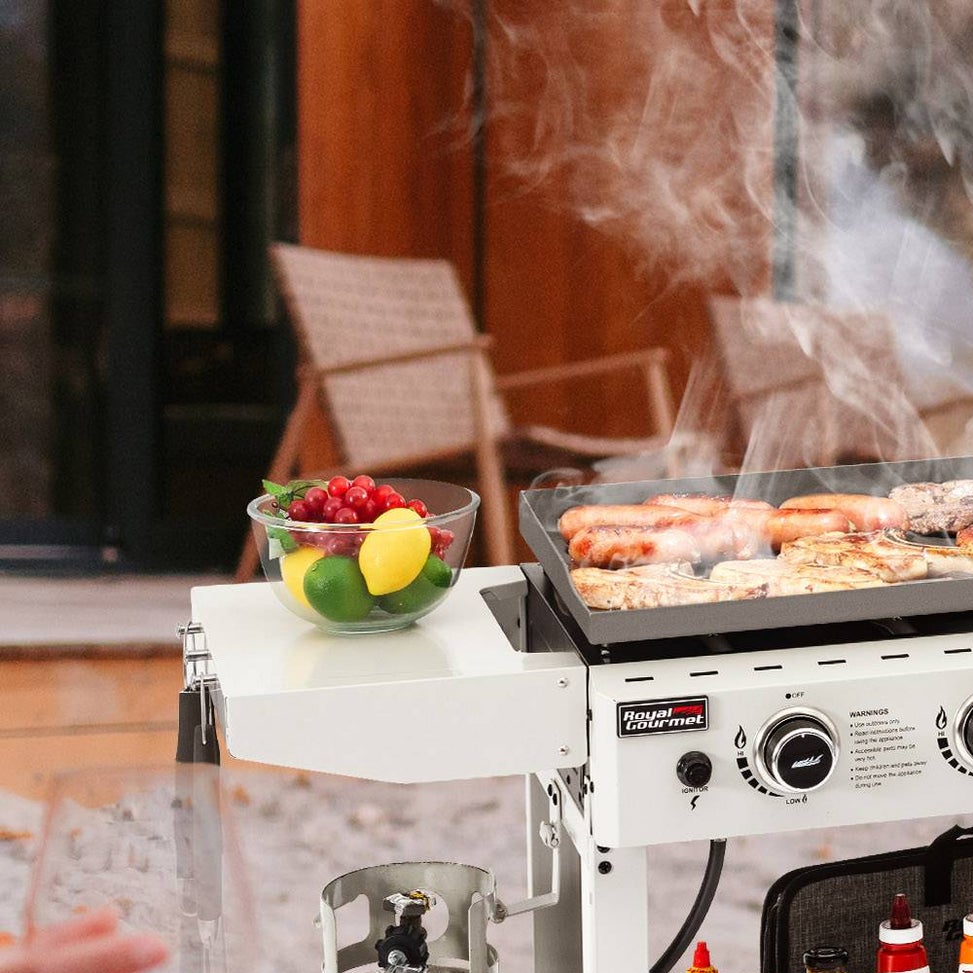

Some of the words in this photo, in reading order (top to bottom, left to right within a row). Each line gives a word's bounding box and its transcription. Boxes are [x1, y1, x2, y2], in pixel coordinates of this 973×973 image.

[624, 708, 673, 721] Royal
[849, 708, 889, 718] WARNINGS
[626, 715, 704, 730] Gourmet
